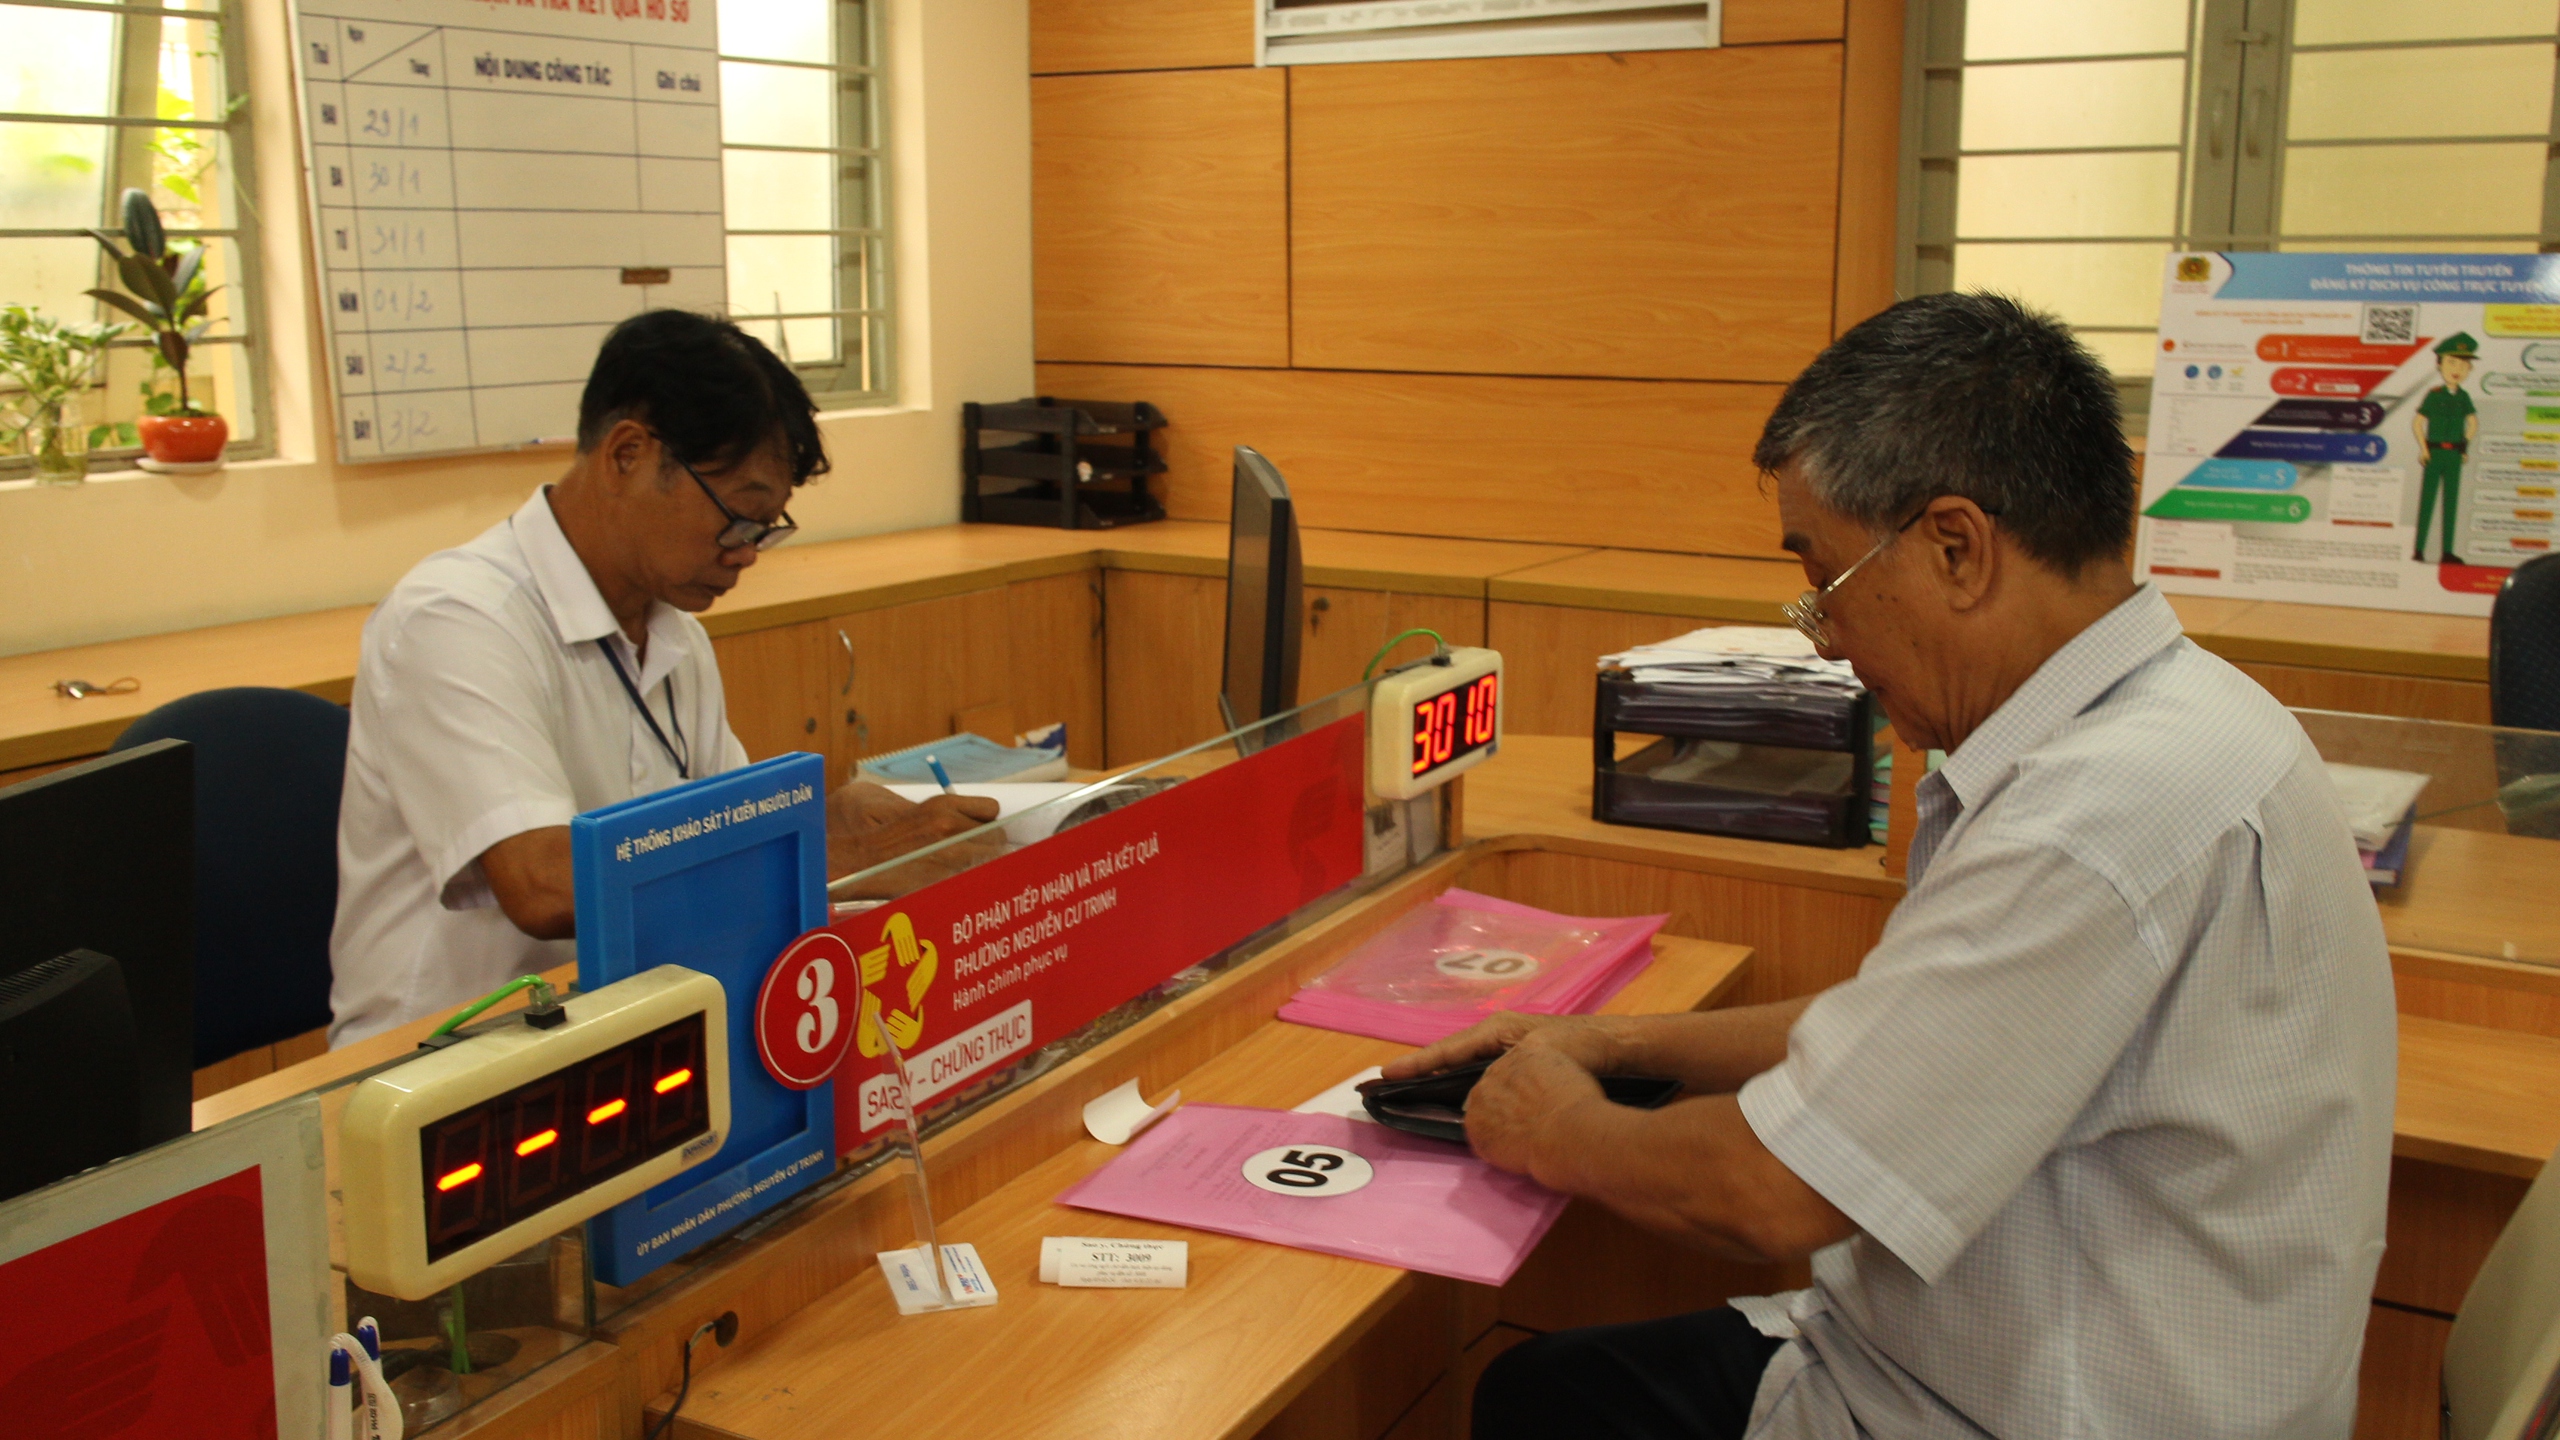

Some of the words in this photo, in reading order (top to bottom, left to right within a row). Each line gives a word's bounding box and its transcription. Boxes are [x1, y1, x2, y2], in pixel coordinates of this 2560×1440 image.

[504, 58, 543, 80] DUNG
[546, 57, 582, 84] CÔNG
[2295, 373, 2308, 391] 2
[2360, 407, 2372, 425] 3
[2364, 440, 2378, 457] 4
[1411, 673, 1497, 774] 3010
[616, 836, 632, 862] HỆ
[632, 828, 671, 855] THỐNG
[672, 816, 702, 843] KHẢO
[702, 810, 722, 834] SÁT
[732, 798, 757, 824] KIẾN
[757, 788, 791, 816] NGƯỜI
[791, 782, 812, 804] DÂN
[953, 913, 973, 944] BỘ
[975, 900, 1011, 935] PHẬN
[1012, 885, 1040, 917] TIẾP
[1041, 872, 1075, 905] NHẬN
[1075, 862, 1091, 889] VÀ
[1091, 851, 1114, 882] TRẢ
[1114, 841, 1136, 872] KẾT
[1136, 831, 1159, 864] QUẢ
[954, 941, 1010, 981] PHƯỜNG
[1013, 909, 1062, 953] NGUYỄN
[1083, 887, 1117, 919] TRINH
[796, 958, 839, 1053] 3
[953, 980, 986, 1012] Hành
[987, 963, 1022, 995] chính
[1023, 950, 1053, 981] phục
[1053, 943, 1069, 963] vụ
[987, 1013, 1026, 1055] THỰC
[651, 1230, 670, 1249] BAN
[671, 1217, 696, 1239] NHÂN
[697, 1206, 716, 1225] DÂN
[717, 1187, 753, 1214] PHƯỜNG
[799, 1149, 824, 1170] TRINH
[1266, 1149, 1344, 1188] 05
